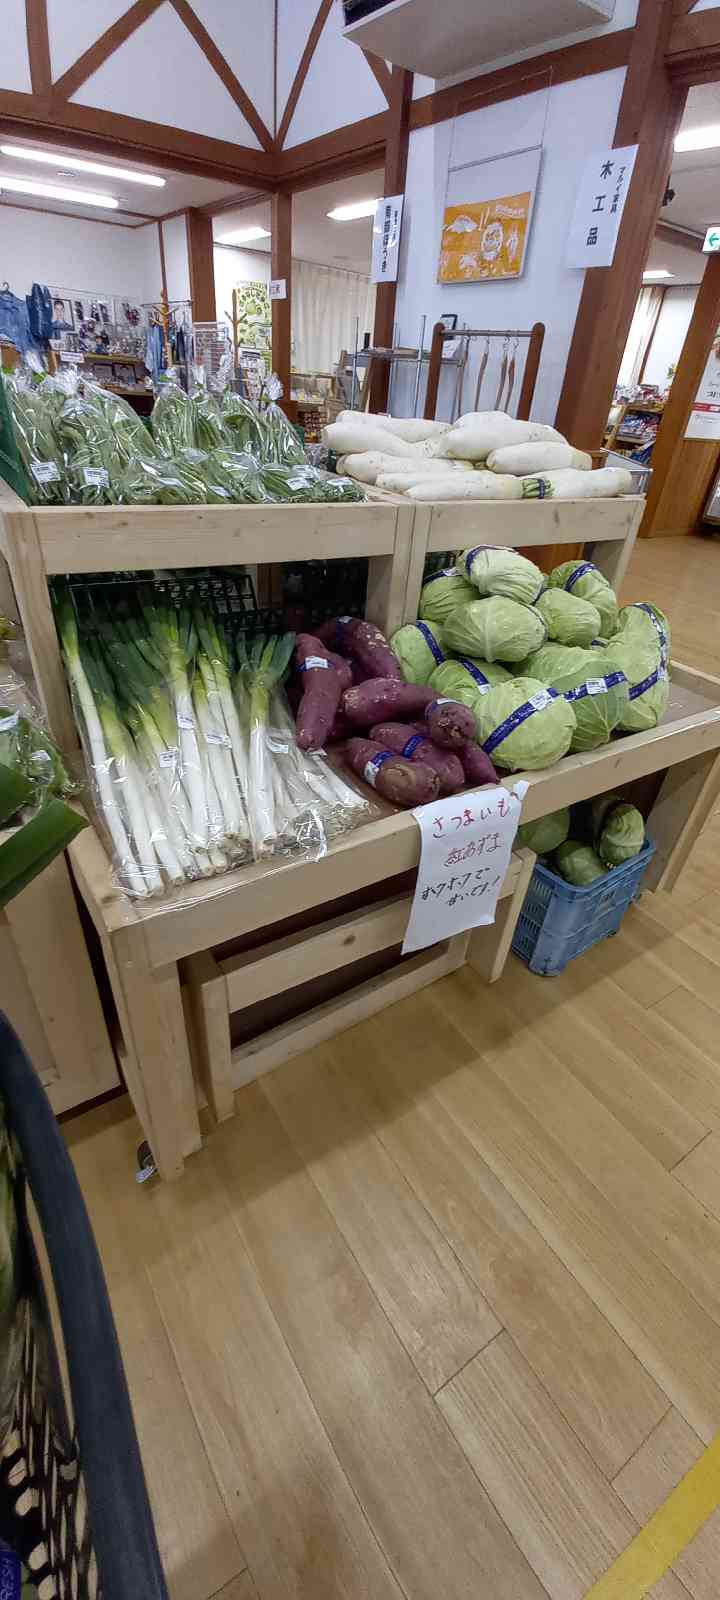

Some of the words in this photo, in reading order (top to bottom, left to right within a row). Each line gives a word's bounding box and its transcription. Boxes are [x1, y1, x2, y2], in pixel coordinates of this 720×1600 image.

[586, 160, 615, 246] 木工品
[433, 798, 510, 839] さつまいも
